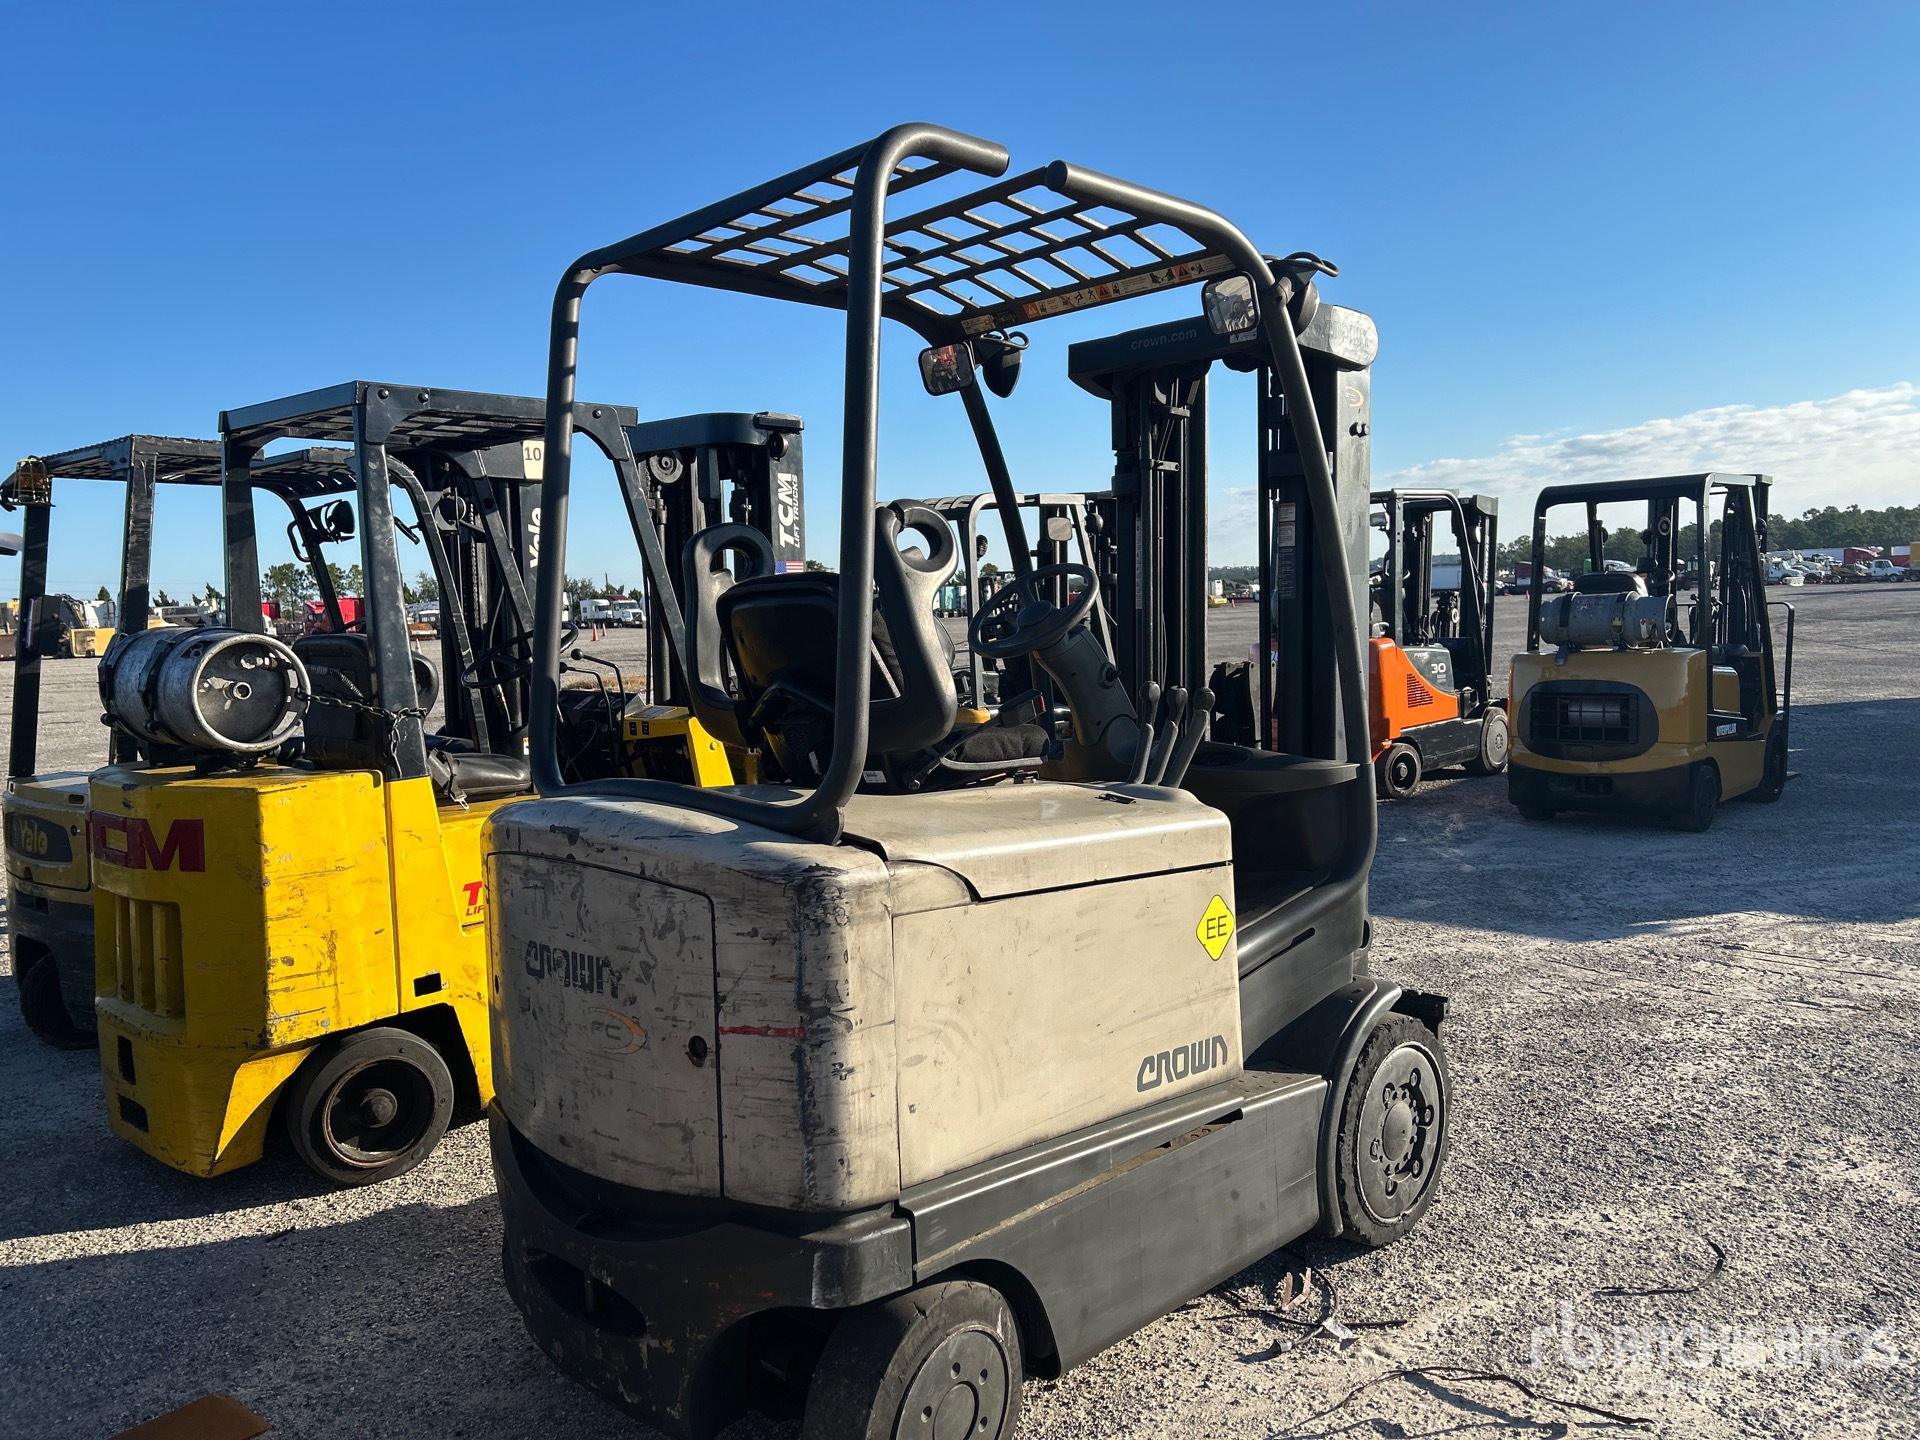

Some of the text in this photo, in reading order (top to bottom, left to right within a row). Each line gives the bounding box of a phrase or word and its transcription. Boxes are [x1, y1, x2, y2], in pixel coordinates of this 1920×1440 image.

[1130, 328, 1198, 351] crown.com
[523, 446, 542, 462] 10
[777, 472, 795, 548] TCM
[791, 473, 801, 549] LIFT TRUCKS
[1430, 662, 1447, 674] 30
[19, 819, 48, 855] Yale
[85, 810, 206, 872] CM
[465, 904, 484, 916] LIF
[1206, 914, 1227, 940] EE
[1136, 1034, 1228, 1093] CROWN
